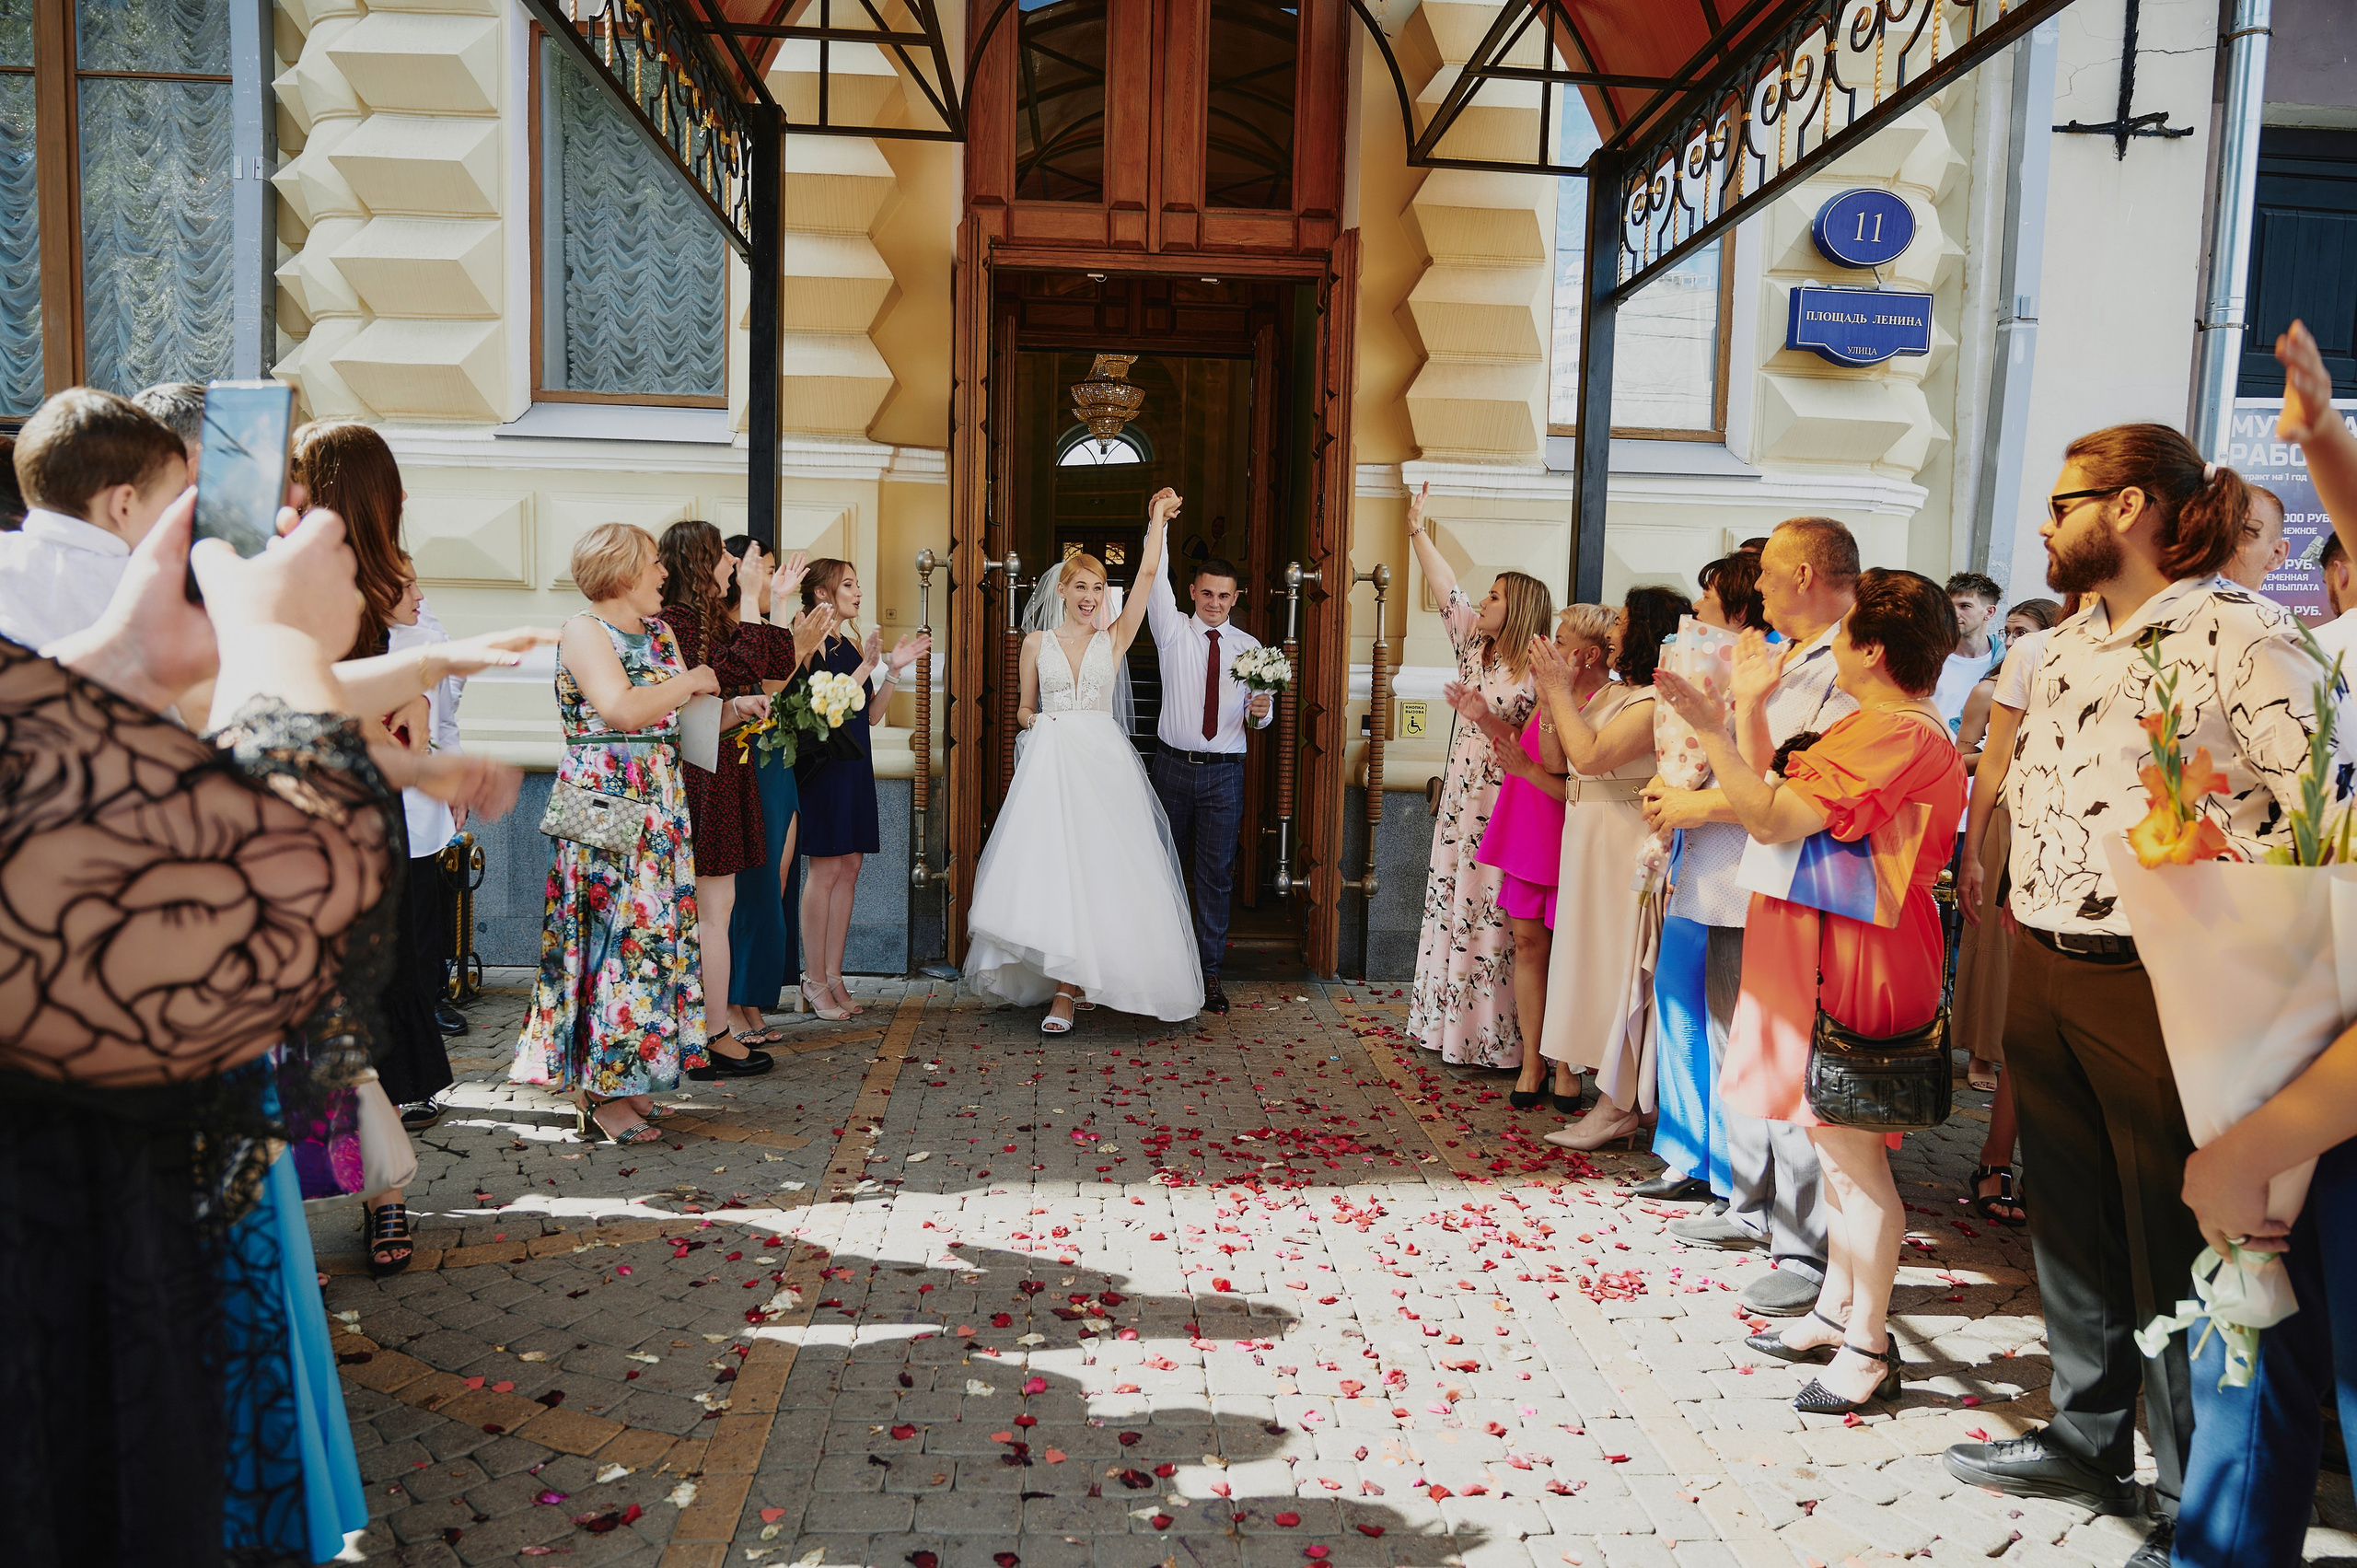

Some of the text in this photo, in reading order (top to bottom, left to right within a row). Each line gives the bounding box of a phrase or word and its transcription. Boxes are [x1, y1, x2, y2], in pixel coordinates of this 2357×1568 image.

[1853, 212, 1883, 242] 11
[1806, 310, 1922, 327] ПЛОЩАДЬ ЛЕНИНА
[1847, 346, 1877, 356] УЛИЦА
[2284, 472, 2290, 481] 1
[2285, 559, 2316, 570] РУБ.
[2293, 606, 2322, 616] РУБ.
